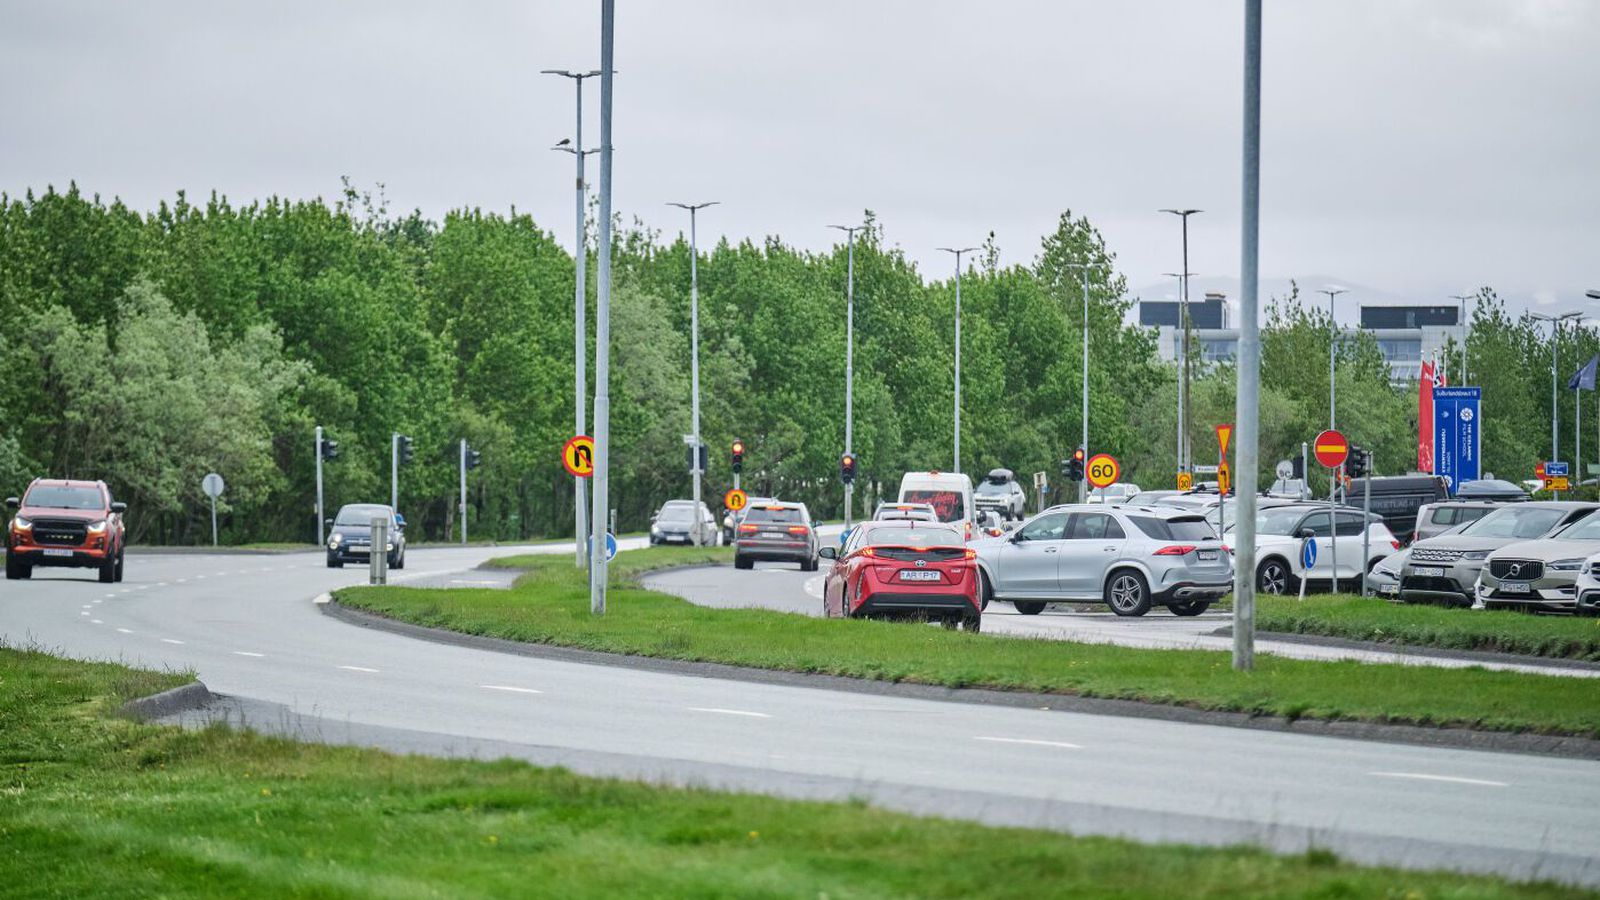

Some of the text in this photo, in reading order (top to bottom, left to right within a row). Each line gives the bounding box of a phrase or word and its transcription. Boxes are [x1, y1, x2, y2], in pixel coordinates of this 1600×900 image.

[1091, 464, 1113, 478] 60
[1181, 480, 1189, 488] 30
[1546, 479, 1552, 488] P
